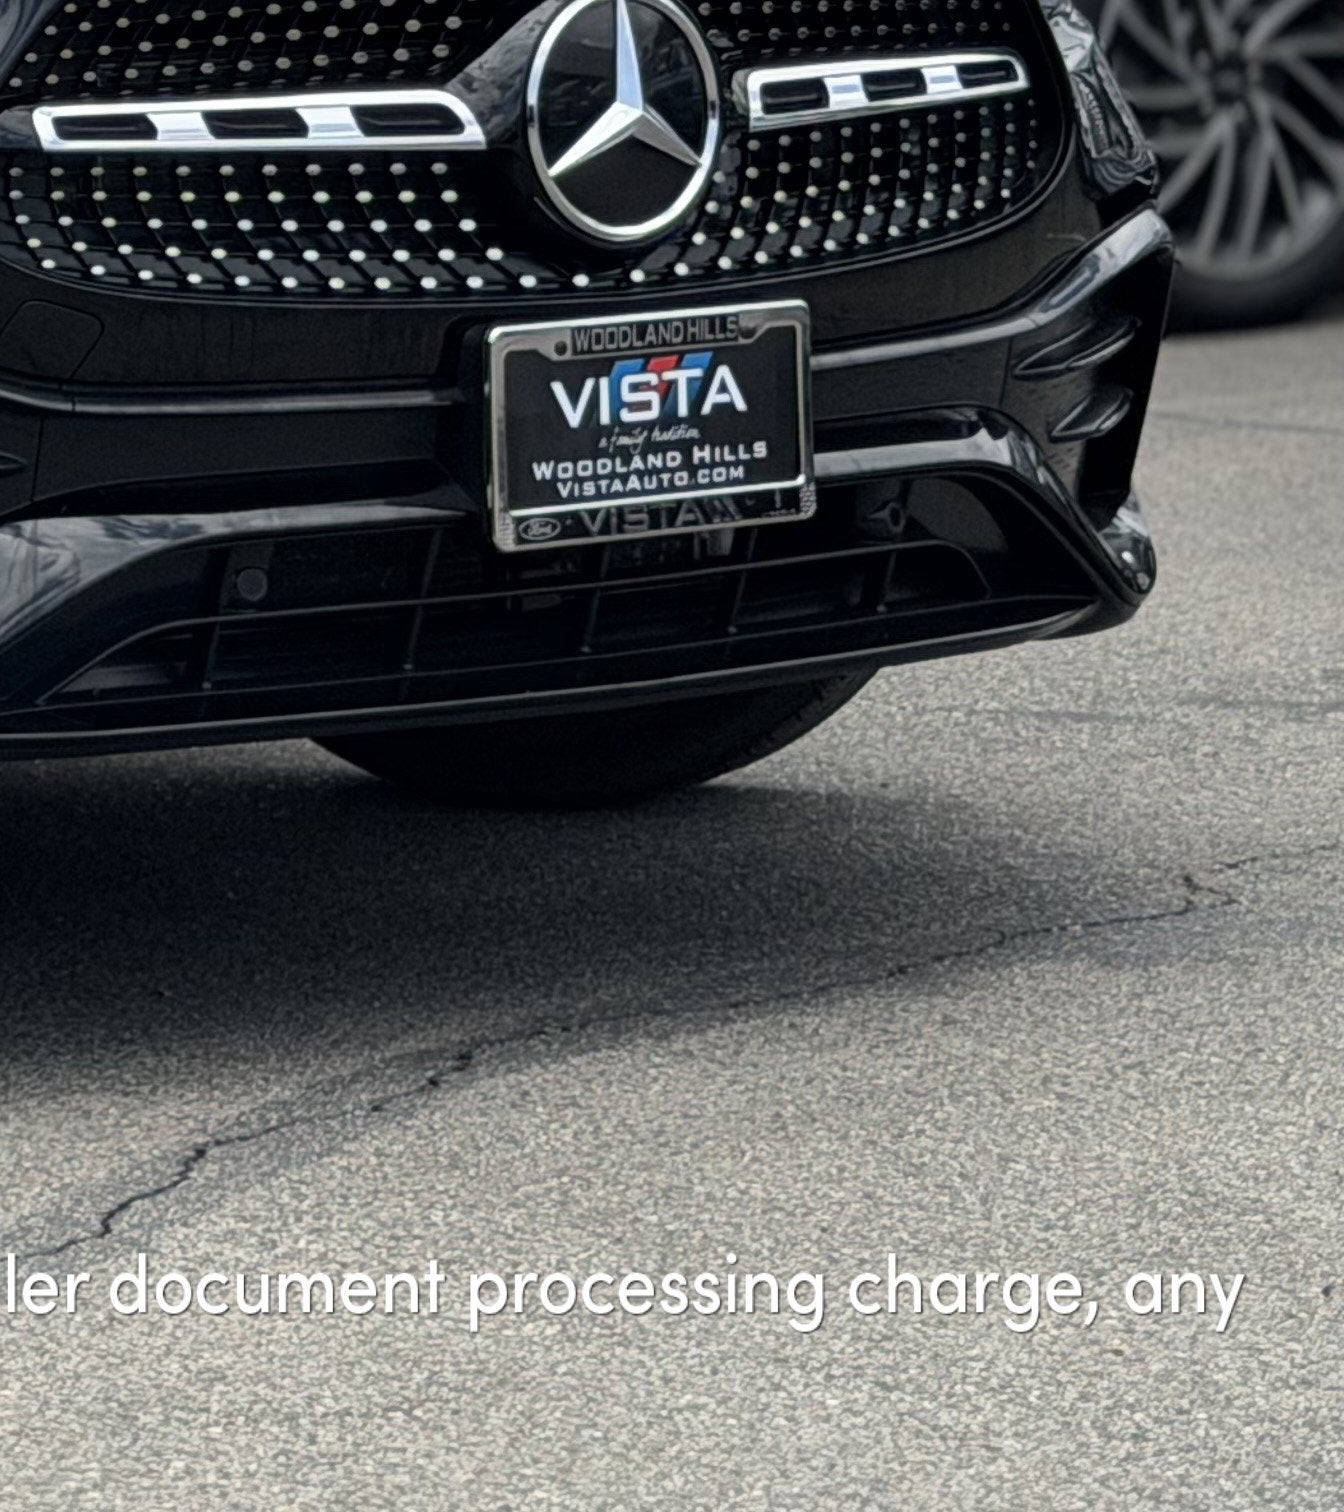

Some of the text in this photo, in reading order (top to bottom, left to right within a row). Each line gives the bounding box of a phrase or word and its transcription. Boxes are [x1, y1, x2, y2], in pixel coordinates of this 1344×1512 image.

[573, 315, 740, 353] WOODLAND HILLS
[549, 363, 748, 429] VISTA
[531, 439, 768, 481] WOODLAND HILLS
